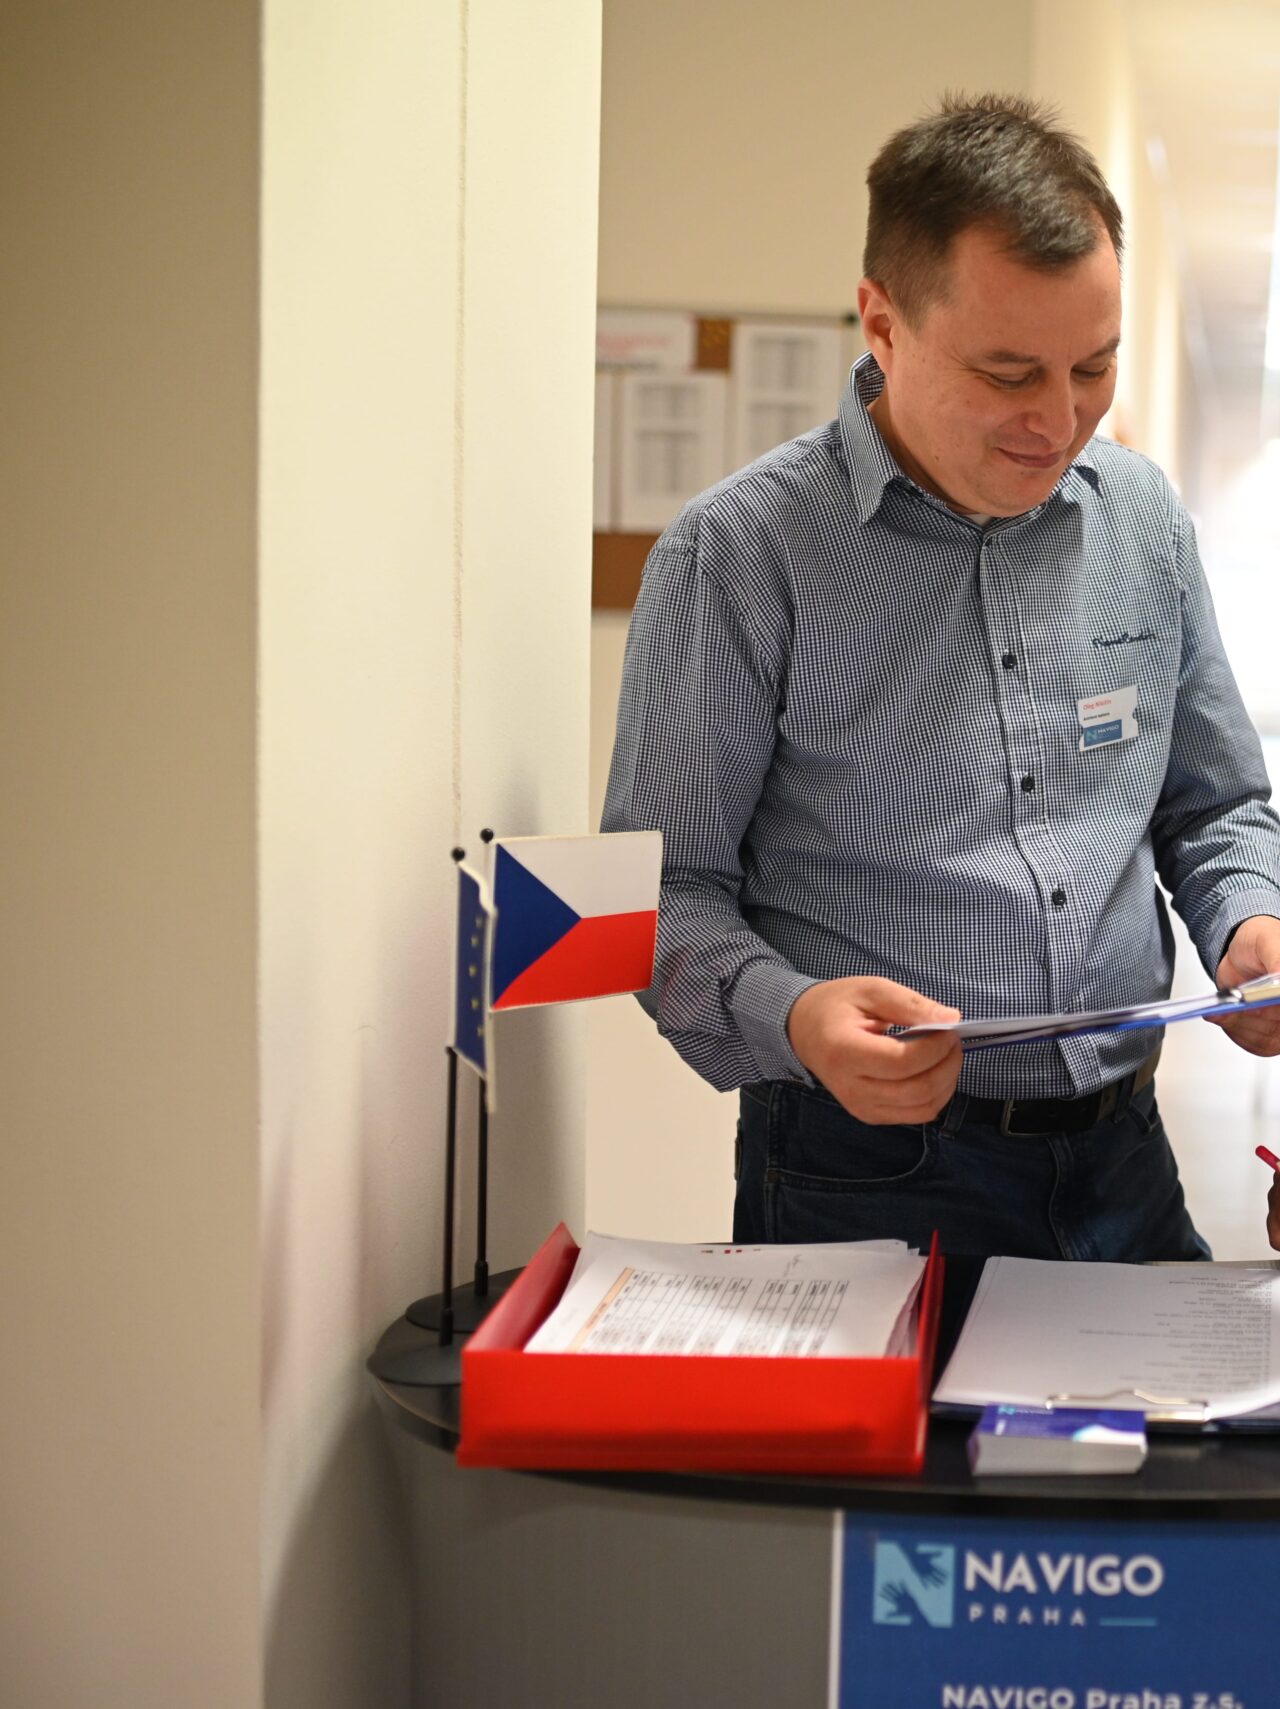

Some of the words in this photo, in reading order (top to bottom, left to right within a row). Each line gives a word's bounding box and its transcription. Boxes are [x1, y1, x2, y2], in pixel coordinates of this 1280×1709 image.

[964, 1550, 1164, 1597] NAVIGO
[969, 1602, 1086, 1627] PRAHA
[941, 1685, 1075, 1709] NAVIGO
[1086, 1687, 1181, 1709] Praha
[1193, 1692, 1243, 1709] z.s.
